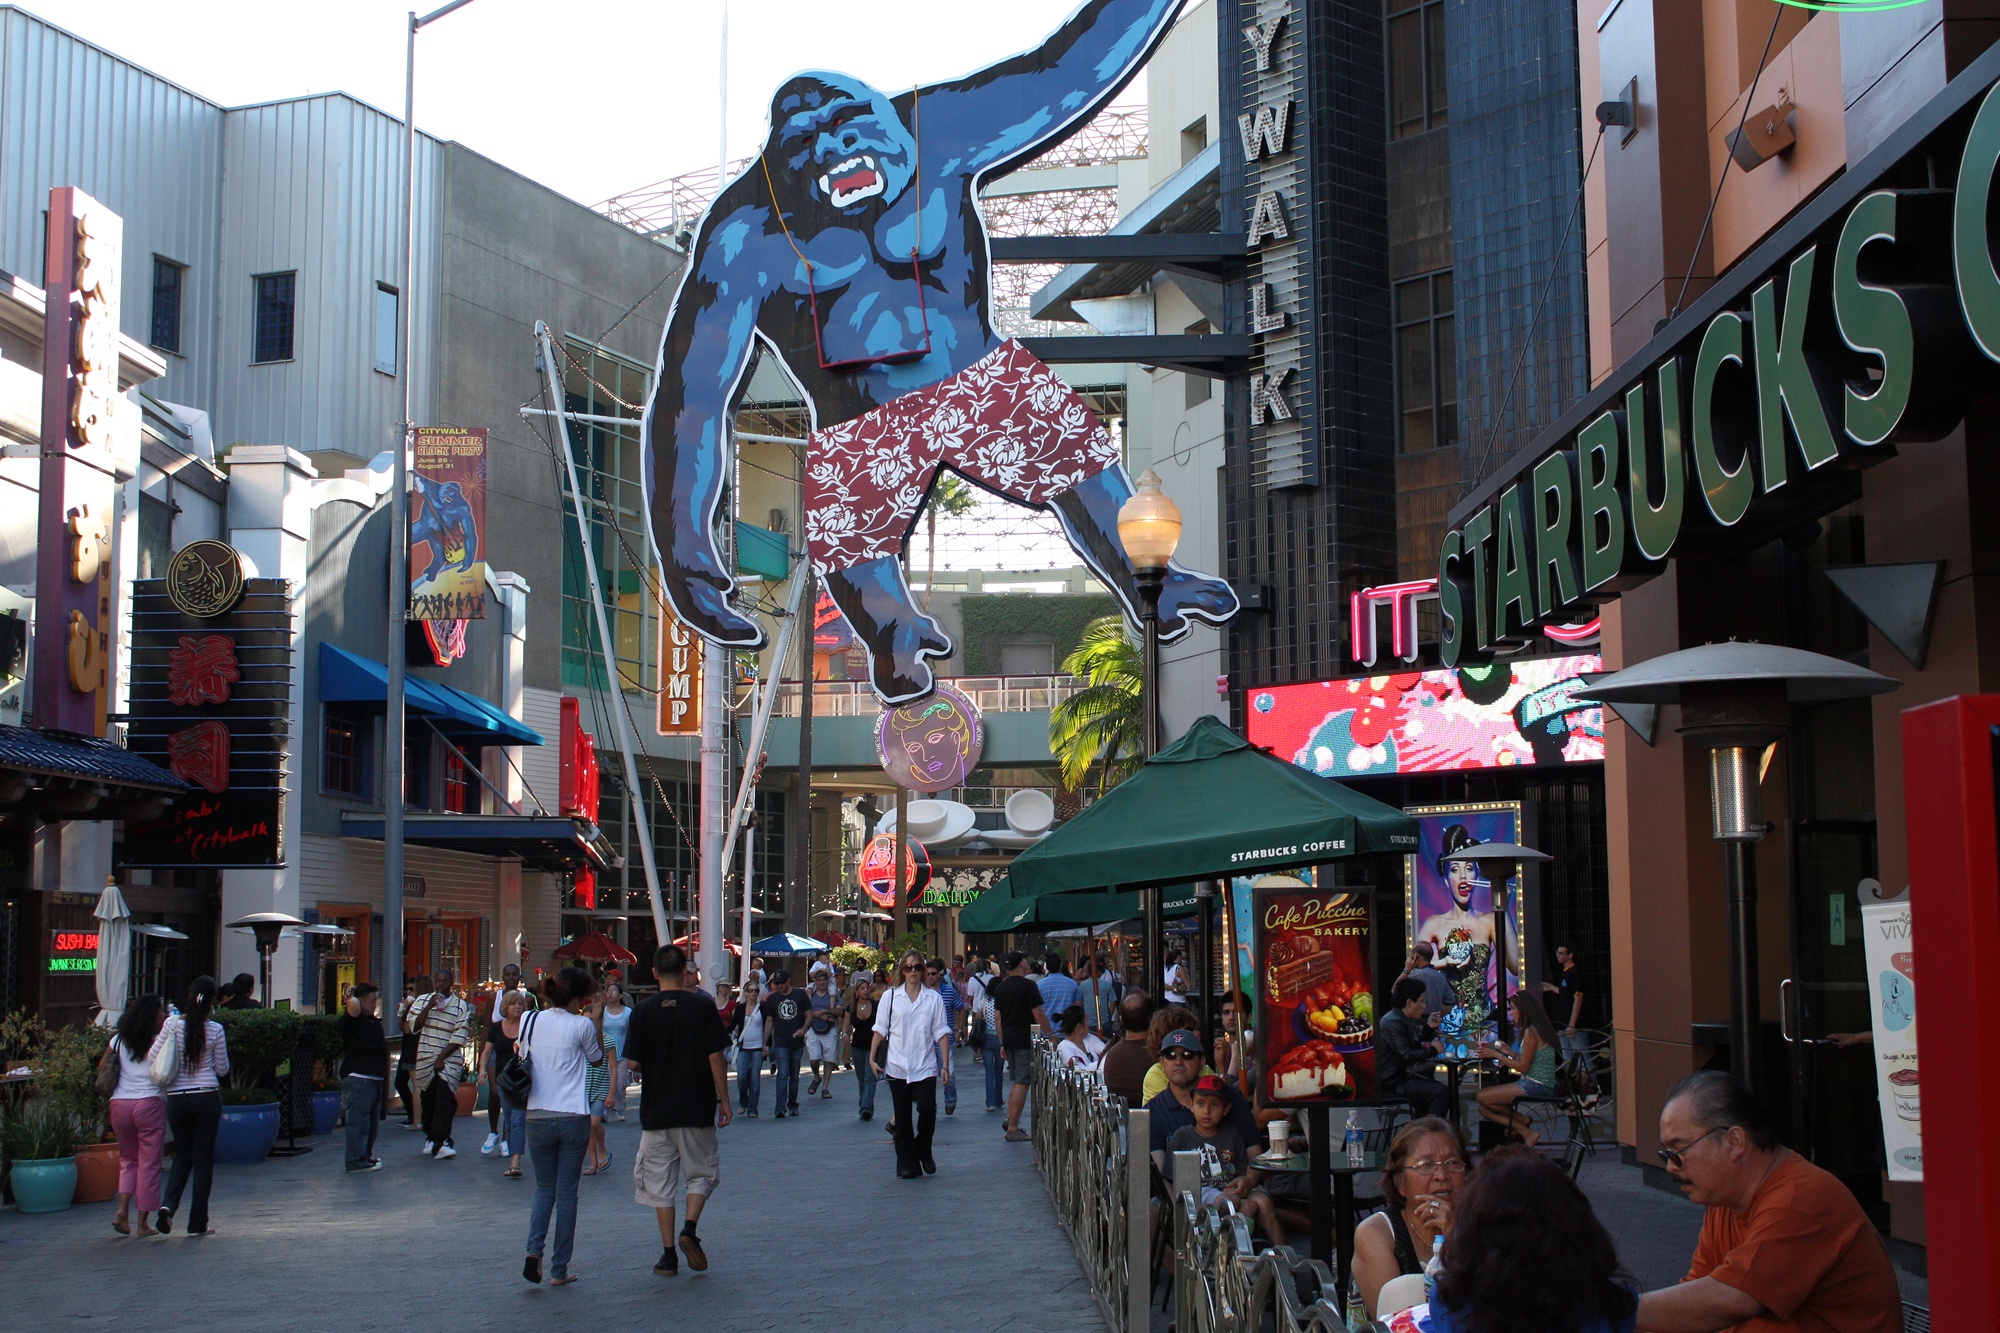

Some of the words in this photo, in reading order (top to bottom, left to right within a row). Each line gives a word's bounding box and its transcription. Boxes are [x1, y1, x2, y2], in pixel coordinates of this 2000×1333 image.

[419, 427, 468, 435] CITYWALK
[1440, 188, 1918, 669] STARBUCKS
[418, 436, 483, 446] SUMMER
[418, 446, 449, 456] BLOCK
[452, 446, 483, 456] PARTY
[668, 617, 691, 725] GUMP
[1231, 846, 1297, 862] STARBUCKS
[1303, 840, 1346, 853] COFFEE
[923, 890, 979, 904] DAILY
[1264, 904, 1302, 930] Cafe
[1302, 899, 1367, 925] Puccino
[1314, 927, 1369, 936] BAKERY
[55, 933, 84, 950] SUSHI
